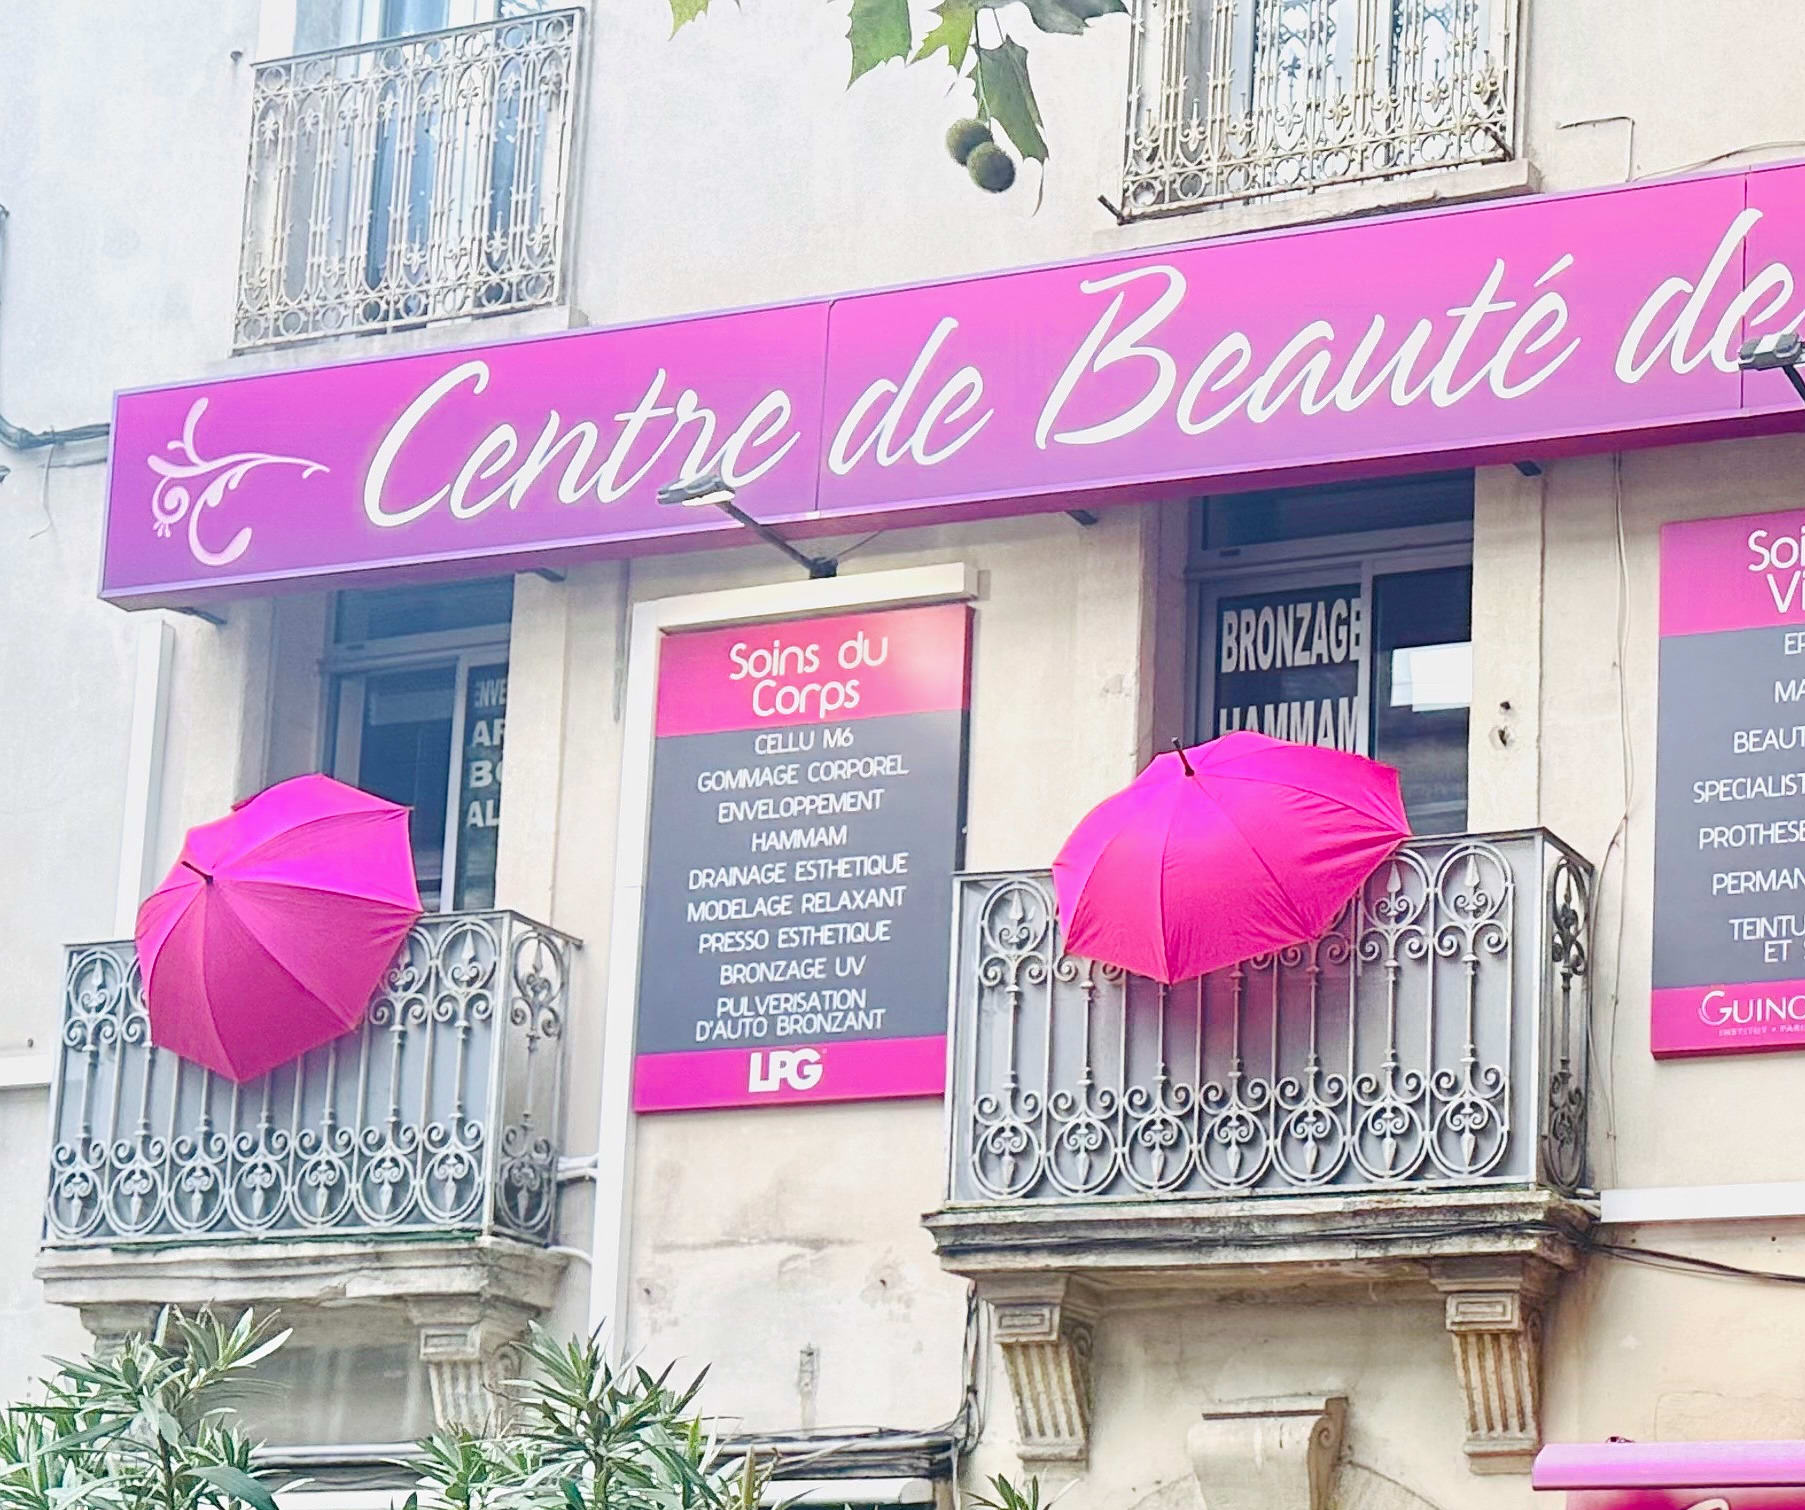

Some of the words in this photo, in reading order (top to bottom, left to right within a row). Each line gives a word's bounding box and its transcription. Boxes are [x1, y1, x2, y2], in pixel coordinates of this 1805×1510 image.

[362, 361, 800, 527] Centre
[828, 316, 995, 475] de
[1034, 254, 1582, 451] Beauté
[1221, 597, 1361, 673] BRONZAGE
[729, 639, 820, 681] Soins
[837, 630, 889, 668] du
[752, 678, 861, 719] Corps
[754, 731, 815, 756] CELLU
[823, 727, 855, 749] M6
[697, 763, 799, 793] GOMMAGE
[807, 754, 909, 783] CORPOREL
[718, 789, 885, 824] ENVELOPPEMENT
[751, 825, 848, 852] HAMMAM
[688, 861, 787, 890] DRAINAGE
[795, 852, 909, 881] ESTHETIQUE
[687, 893, 793, 923] MODELAGE
[801, 885, 907, 913] RELAXANT
[698, 927, 769, 953] PRESSO
[777, 920, 891, 949] ESTHETIQUE
[1764, 939, 1793, 964] ET
[719, 958, 827, 985] BRONZAGE
[834, 955, 867, 977] UV
[716, 988, 867, 1017] PULVERISATION
[695, 1014, 768, 1042] D'AUTO
[776, 1008, 886, 1037] BRONZANT
[748, 1047, 824, 1092] LPG
